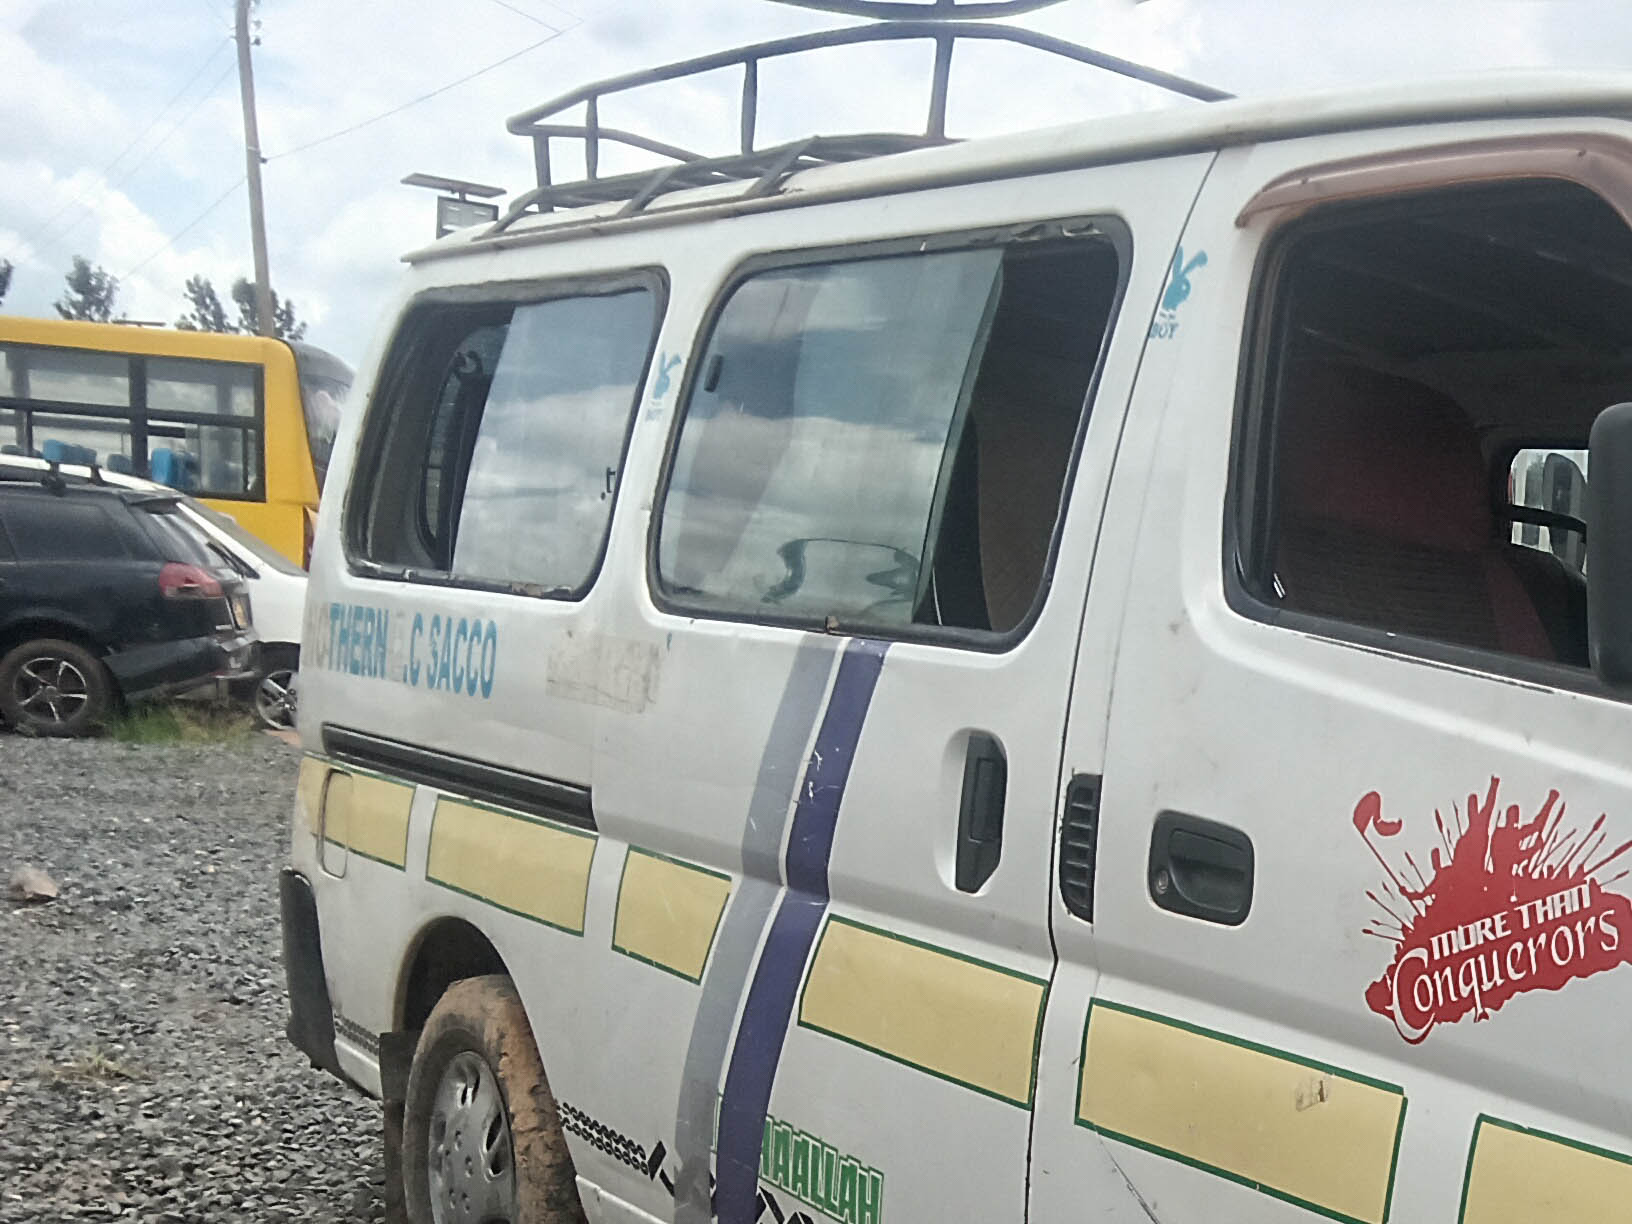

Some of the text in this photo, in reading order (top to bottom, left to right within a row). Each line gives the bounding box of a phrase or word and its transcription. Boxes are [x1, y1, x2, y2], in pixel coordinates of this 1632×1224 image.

[426, 614, 497, 699] SACCO
[1430, 881, 1591, 960] MORE THAN
[1386, 909, 1619, 1033] Conquerors
